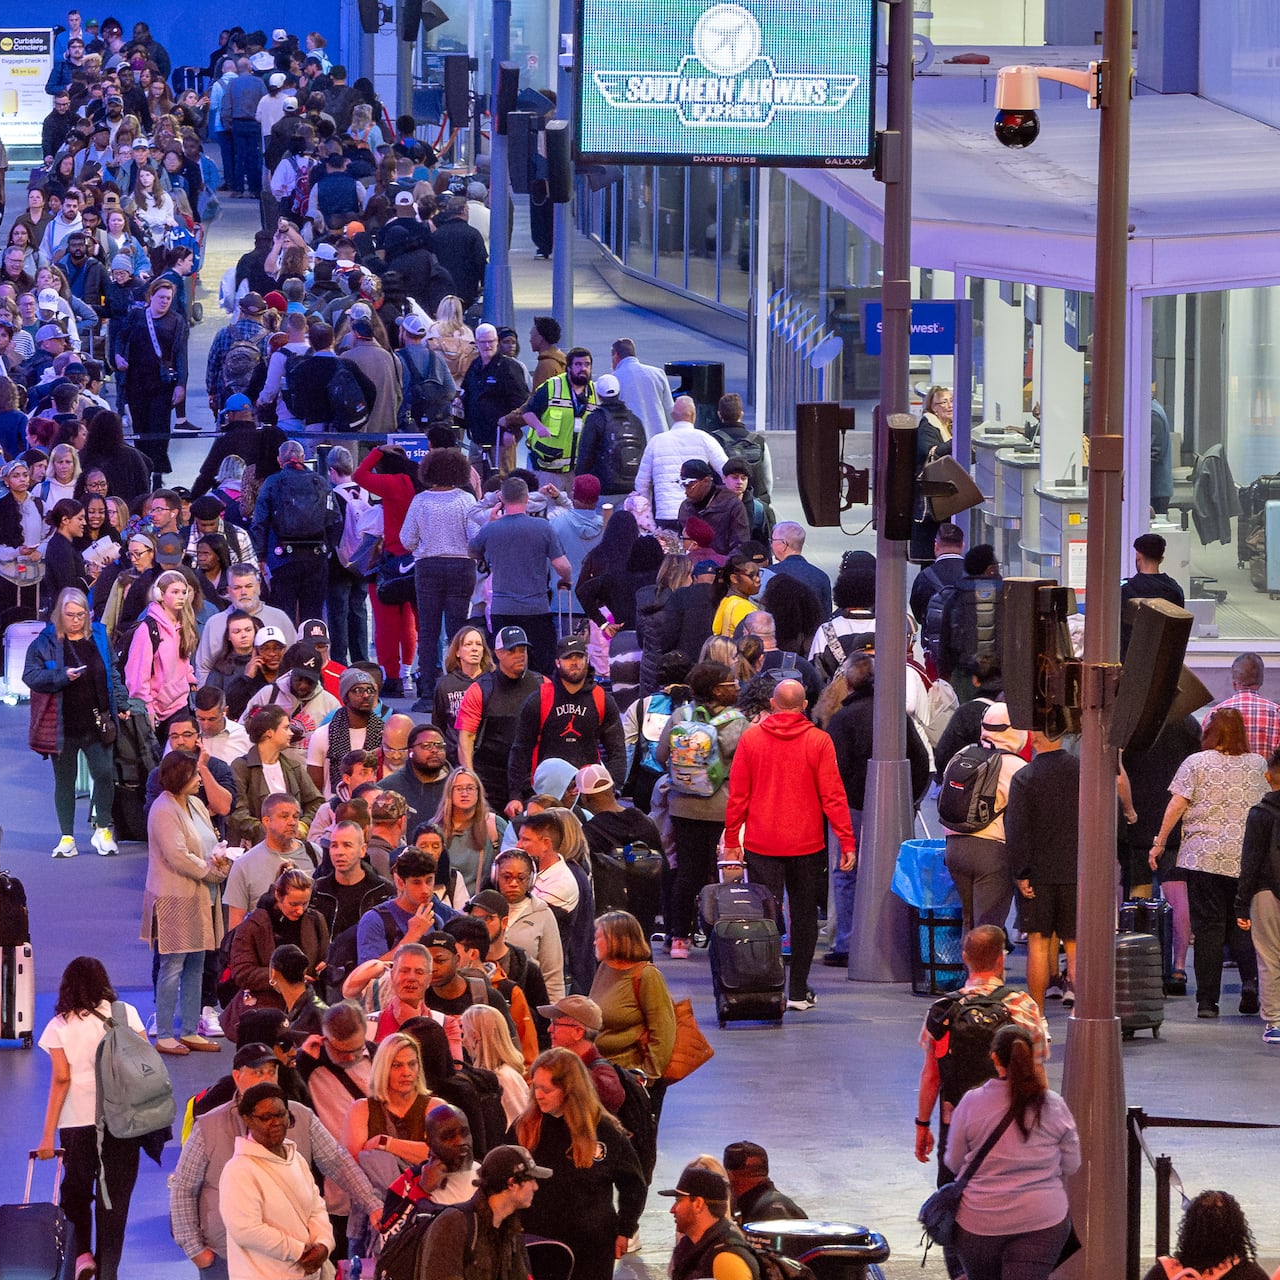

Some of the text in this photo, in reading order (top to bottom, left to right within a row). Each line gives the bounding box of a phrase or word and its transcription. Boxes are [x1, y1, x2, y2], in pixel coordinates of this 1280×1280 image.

[626, 77, 828, 103] SOUTHERN AIRWAYS
[693, 156, 864, 166] DAKTRONICS GALAXY
[876, 321, 939, 333] Swest
[555, 703, 588, 717] DUBAI
